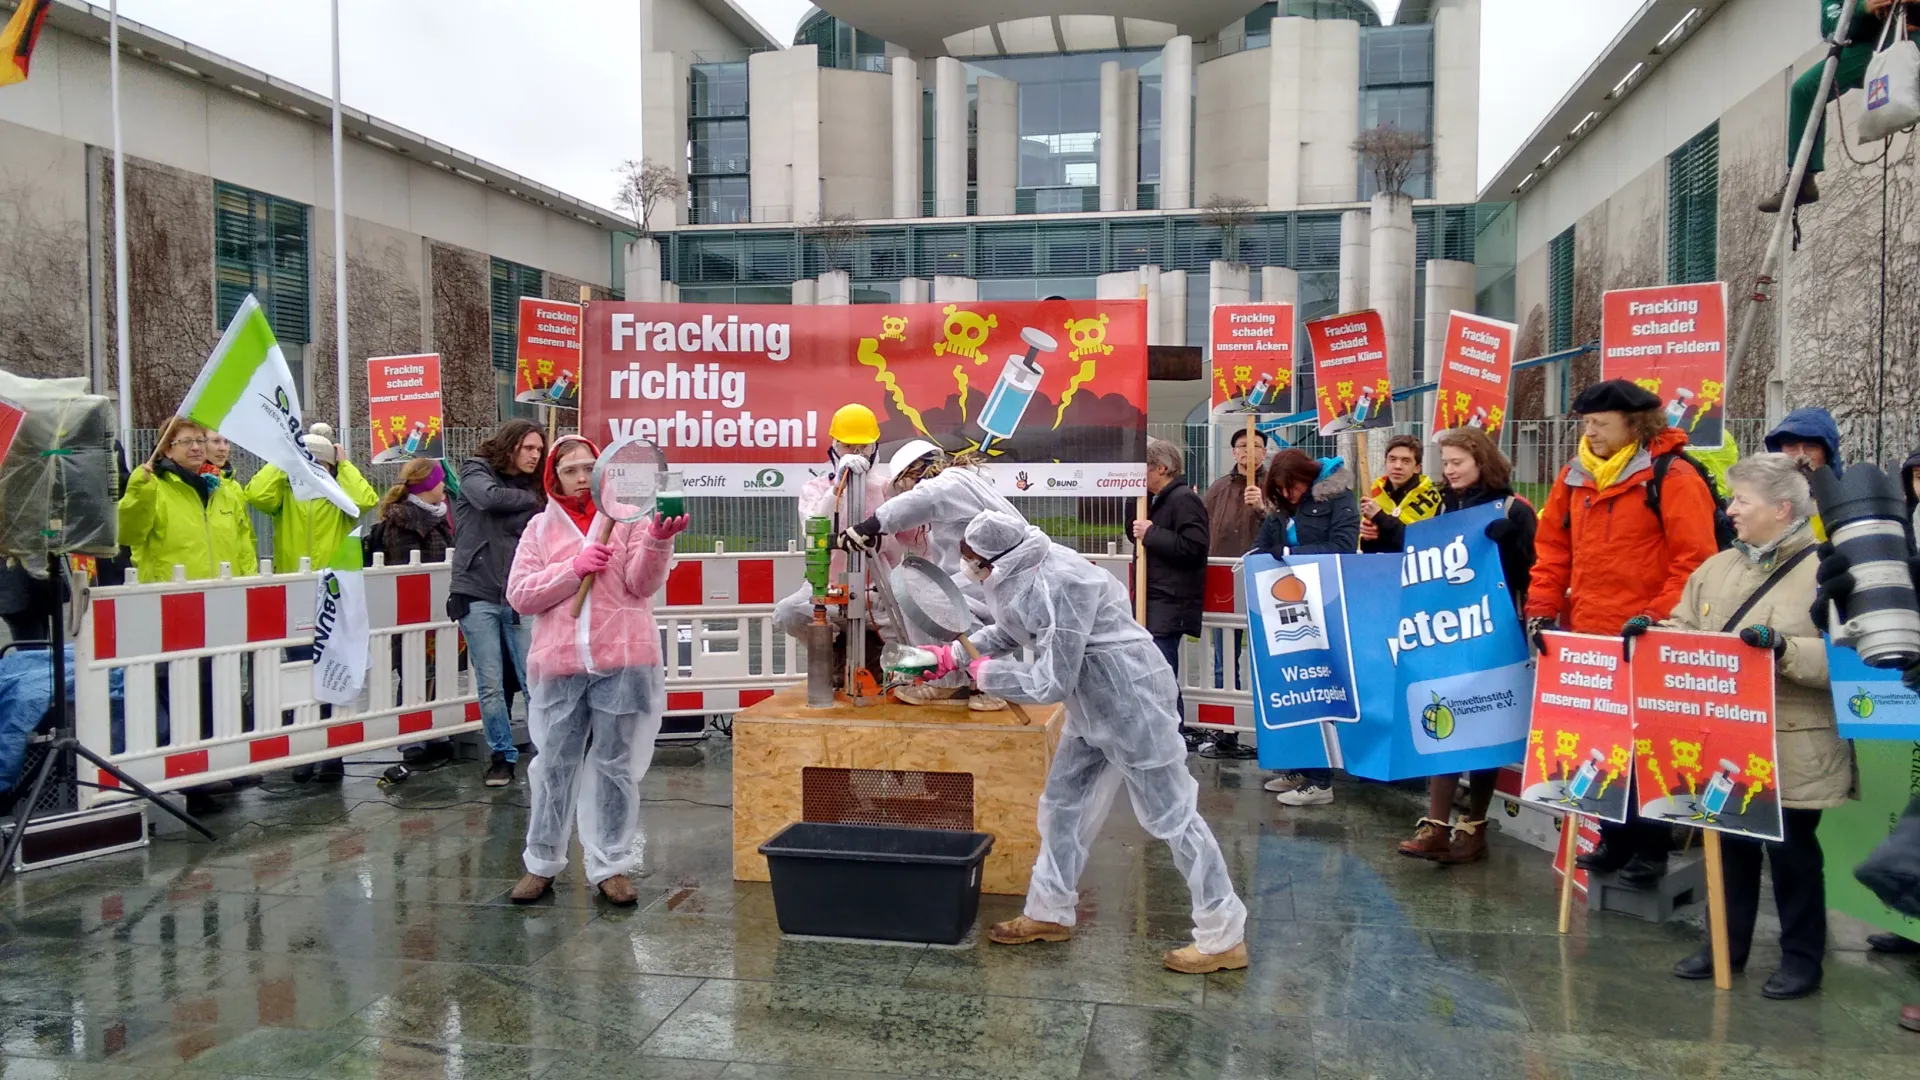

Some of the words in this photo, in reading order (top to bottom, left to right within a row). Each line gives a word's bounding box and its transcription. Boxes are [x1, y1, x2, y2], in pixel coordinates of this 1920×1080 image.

[536, 308, 579, 325] Fracking
[1629, 299, 1698, 317] Fracking
[1230, 313, 1276, 325] Fracking
[1632, 318, 1696, 336] schadet
[537, 323, 576, 335] schadet
[611, 313, 791, 361] Fracking
[1232, 327, 1274, 337] schadet
[1324, 322, 1368, 338] Fracking
[1461, 327, 1500, 349] Fracking
[528, 336, 565, 347] unserem
[1216, 343, 1254, 351] unseren
[1255, 339, 1289, 351] Äckern
[1330, 336, 1369, 352] schadet
[1607, 344, 1663, 358] unseren
[1666, 340, 1720, 355] Feldern
[1320, 356, 1356, 368] unserem
[1357, 350, 1382, 362] Klima
[1460, 345, 1496, 364] schadet
[384, 365, 424, 376] Fracking
[1449, 361, 1481, 378] unseren
[1481, 368, 1502, 384] Seen
[386, 378, 423, 388] schadet
[610, 362, 746, 408] richtig
[371, 395, 399, 403] unserer
[400, 391, 440, 401] Landschaft
[608, 410, 817, 448] verbieten!
[1096, 477, 1147, 490] campact
[1560, 647, 1617, 671] Fracking
[1659, 645, 1740, 673] Fracking
[1281, 665, 1332, 683] Wasser-
[1560, 671, 1614, 691] schadet
[1664, 673, 1737, 695] schadet
[1270, 689, 1347, 709] Schutzgebiet
[1447, 689, 1514, 708] Umweltinstitut
[1453, 703, 1493, 716] München
[1496, 698, 1517, 709] e.V.
[1541, 691, 1592, 710] unserem
[1593, 697, 1628, 715] Klima
[1638, 696, 1701, 716] unseren
[1705, 702, 1768, 725] Feldern
